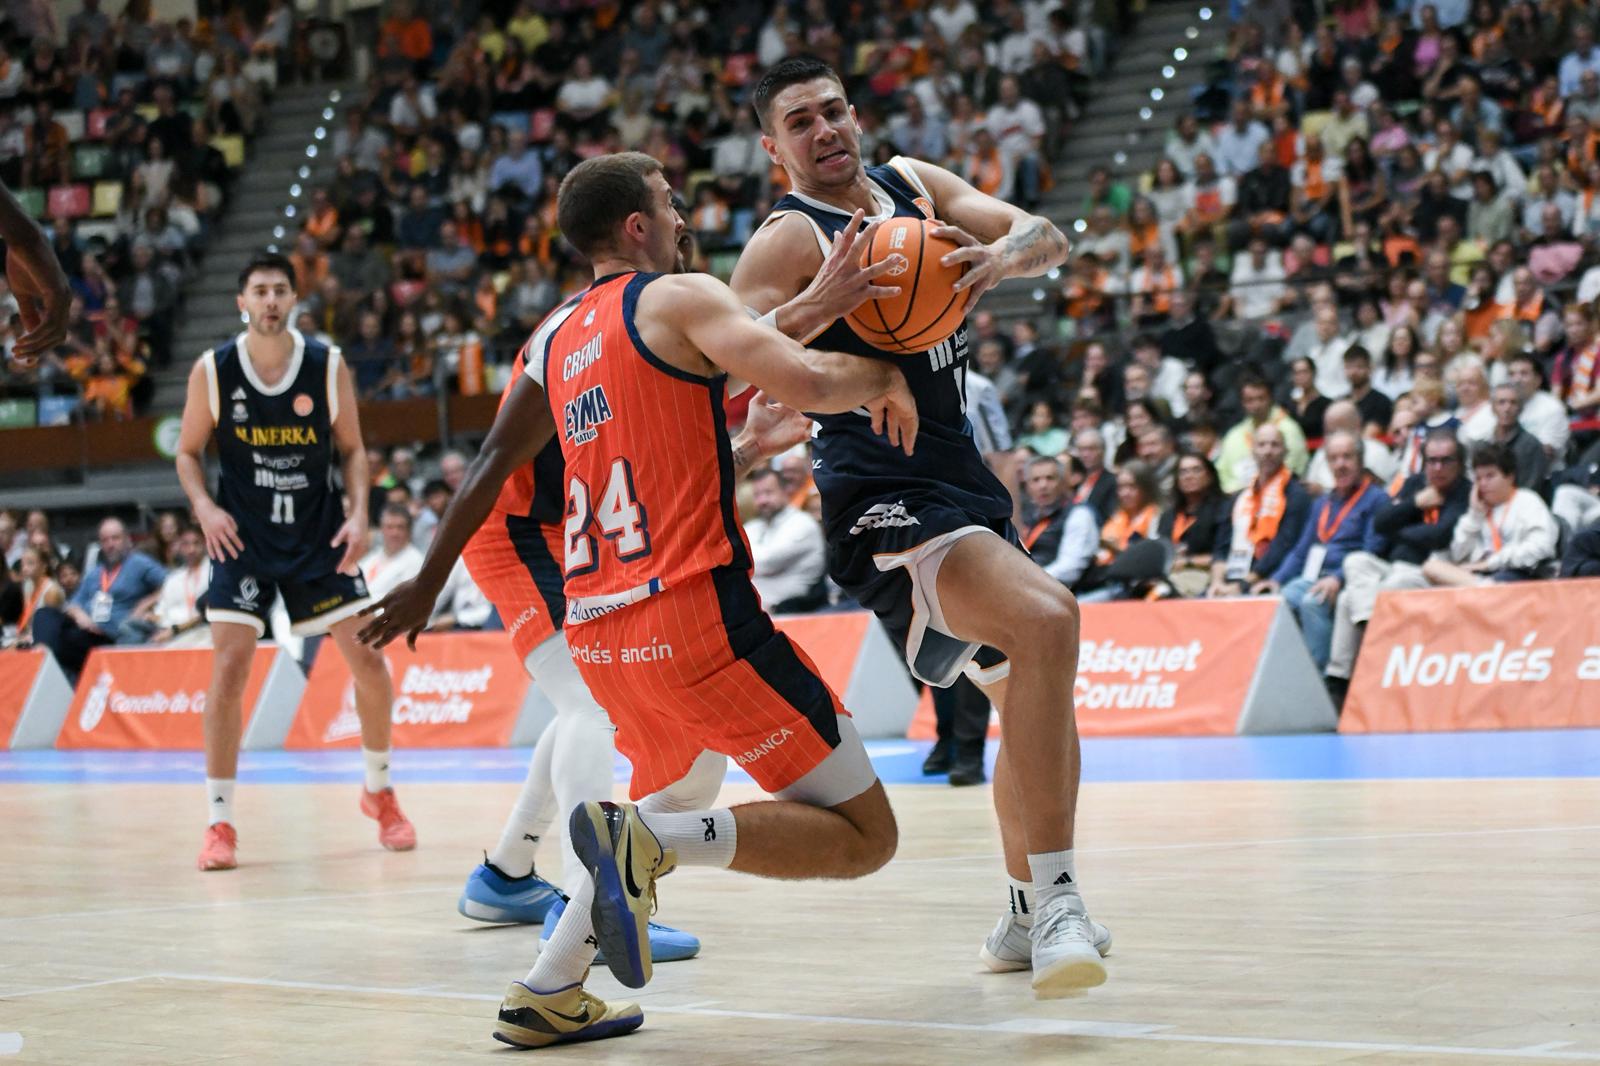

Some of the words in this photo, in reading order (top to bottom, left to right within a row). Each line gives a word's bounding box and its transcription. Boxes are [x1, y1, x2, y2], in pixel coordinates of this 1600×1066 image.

[563, 331, 602, 382] CREMO
[565, 385, 612, 443] EYMA
[270, 493, 295, 524] 11
[564, 456, 652, 578] 24
[570, 641, 612, 664] ordés
[621, 636, 673, 664] ancín
[1077, 640, 1202, 680] Básquet
[1381, 631, 1554, 689] Nordés
[402, 664, 492, 700] Básquet
[1073, 674, 1178, 709] Coruña
[391, 694, 474, 724] Coruña
[736, 727, 794, 765] ABANCA
